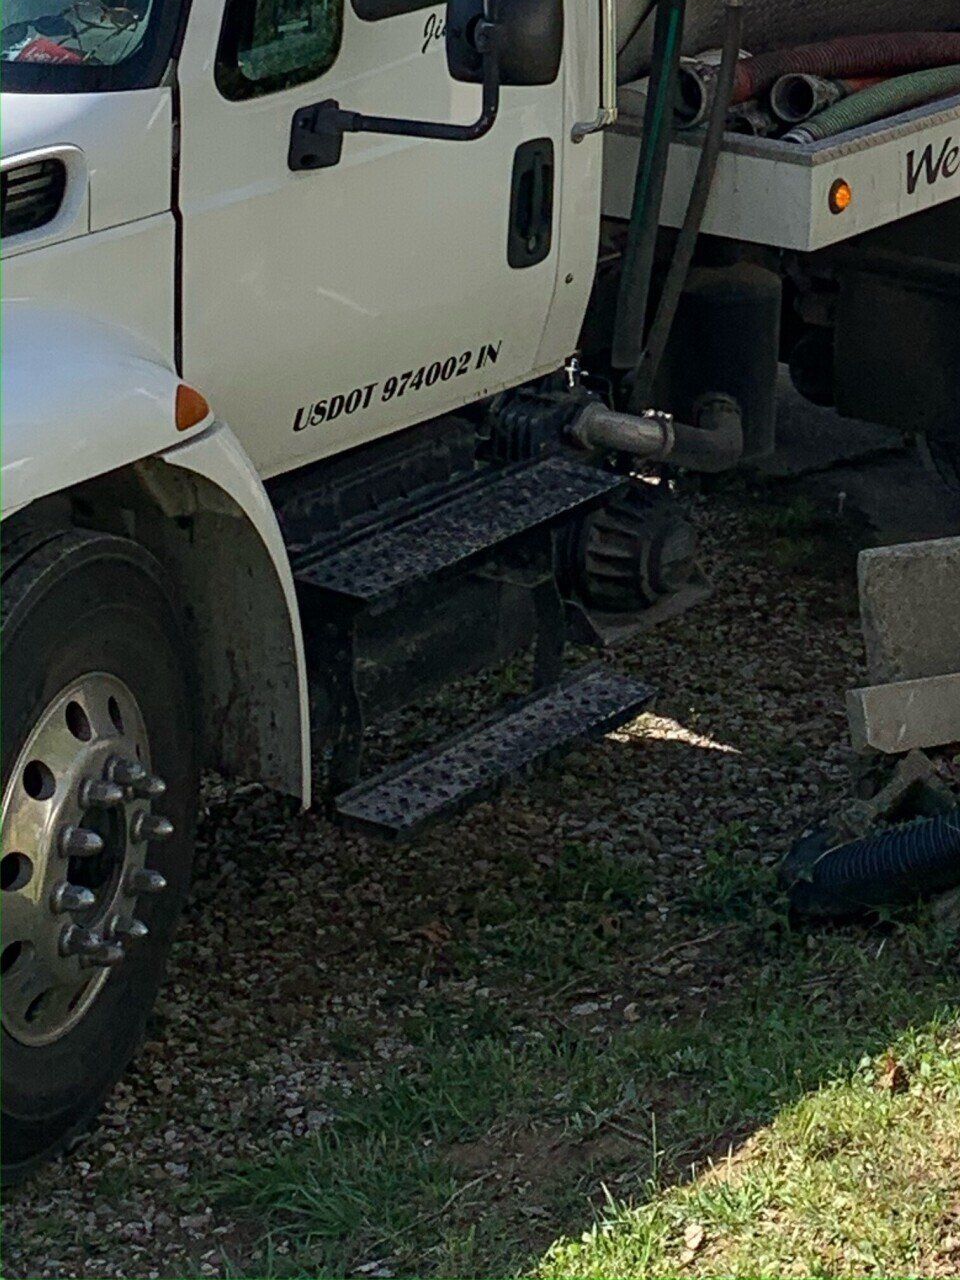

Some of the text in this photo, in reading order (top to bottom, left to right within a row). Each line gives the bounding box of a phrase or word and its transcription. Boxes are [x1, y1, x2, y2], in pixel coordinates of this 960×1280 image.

[293, 340, 502, 432] USDOT 974002 IN
